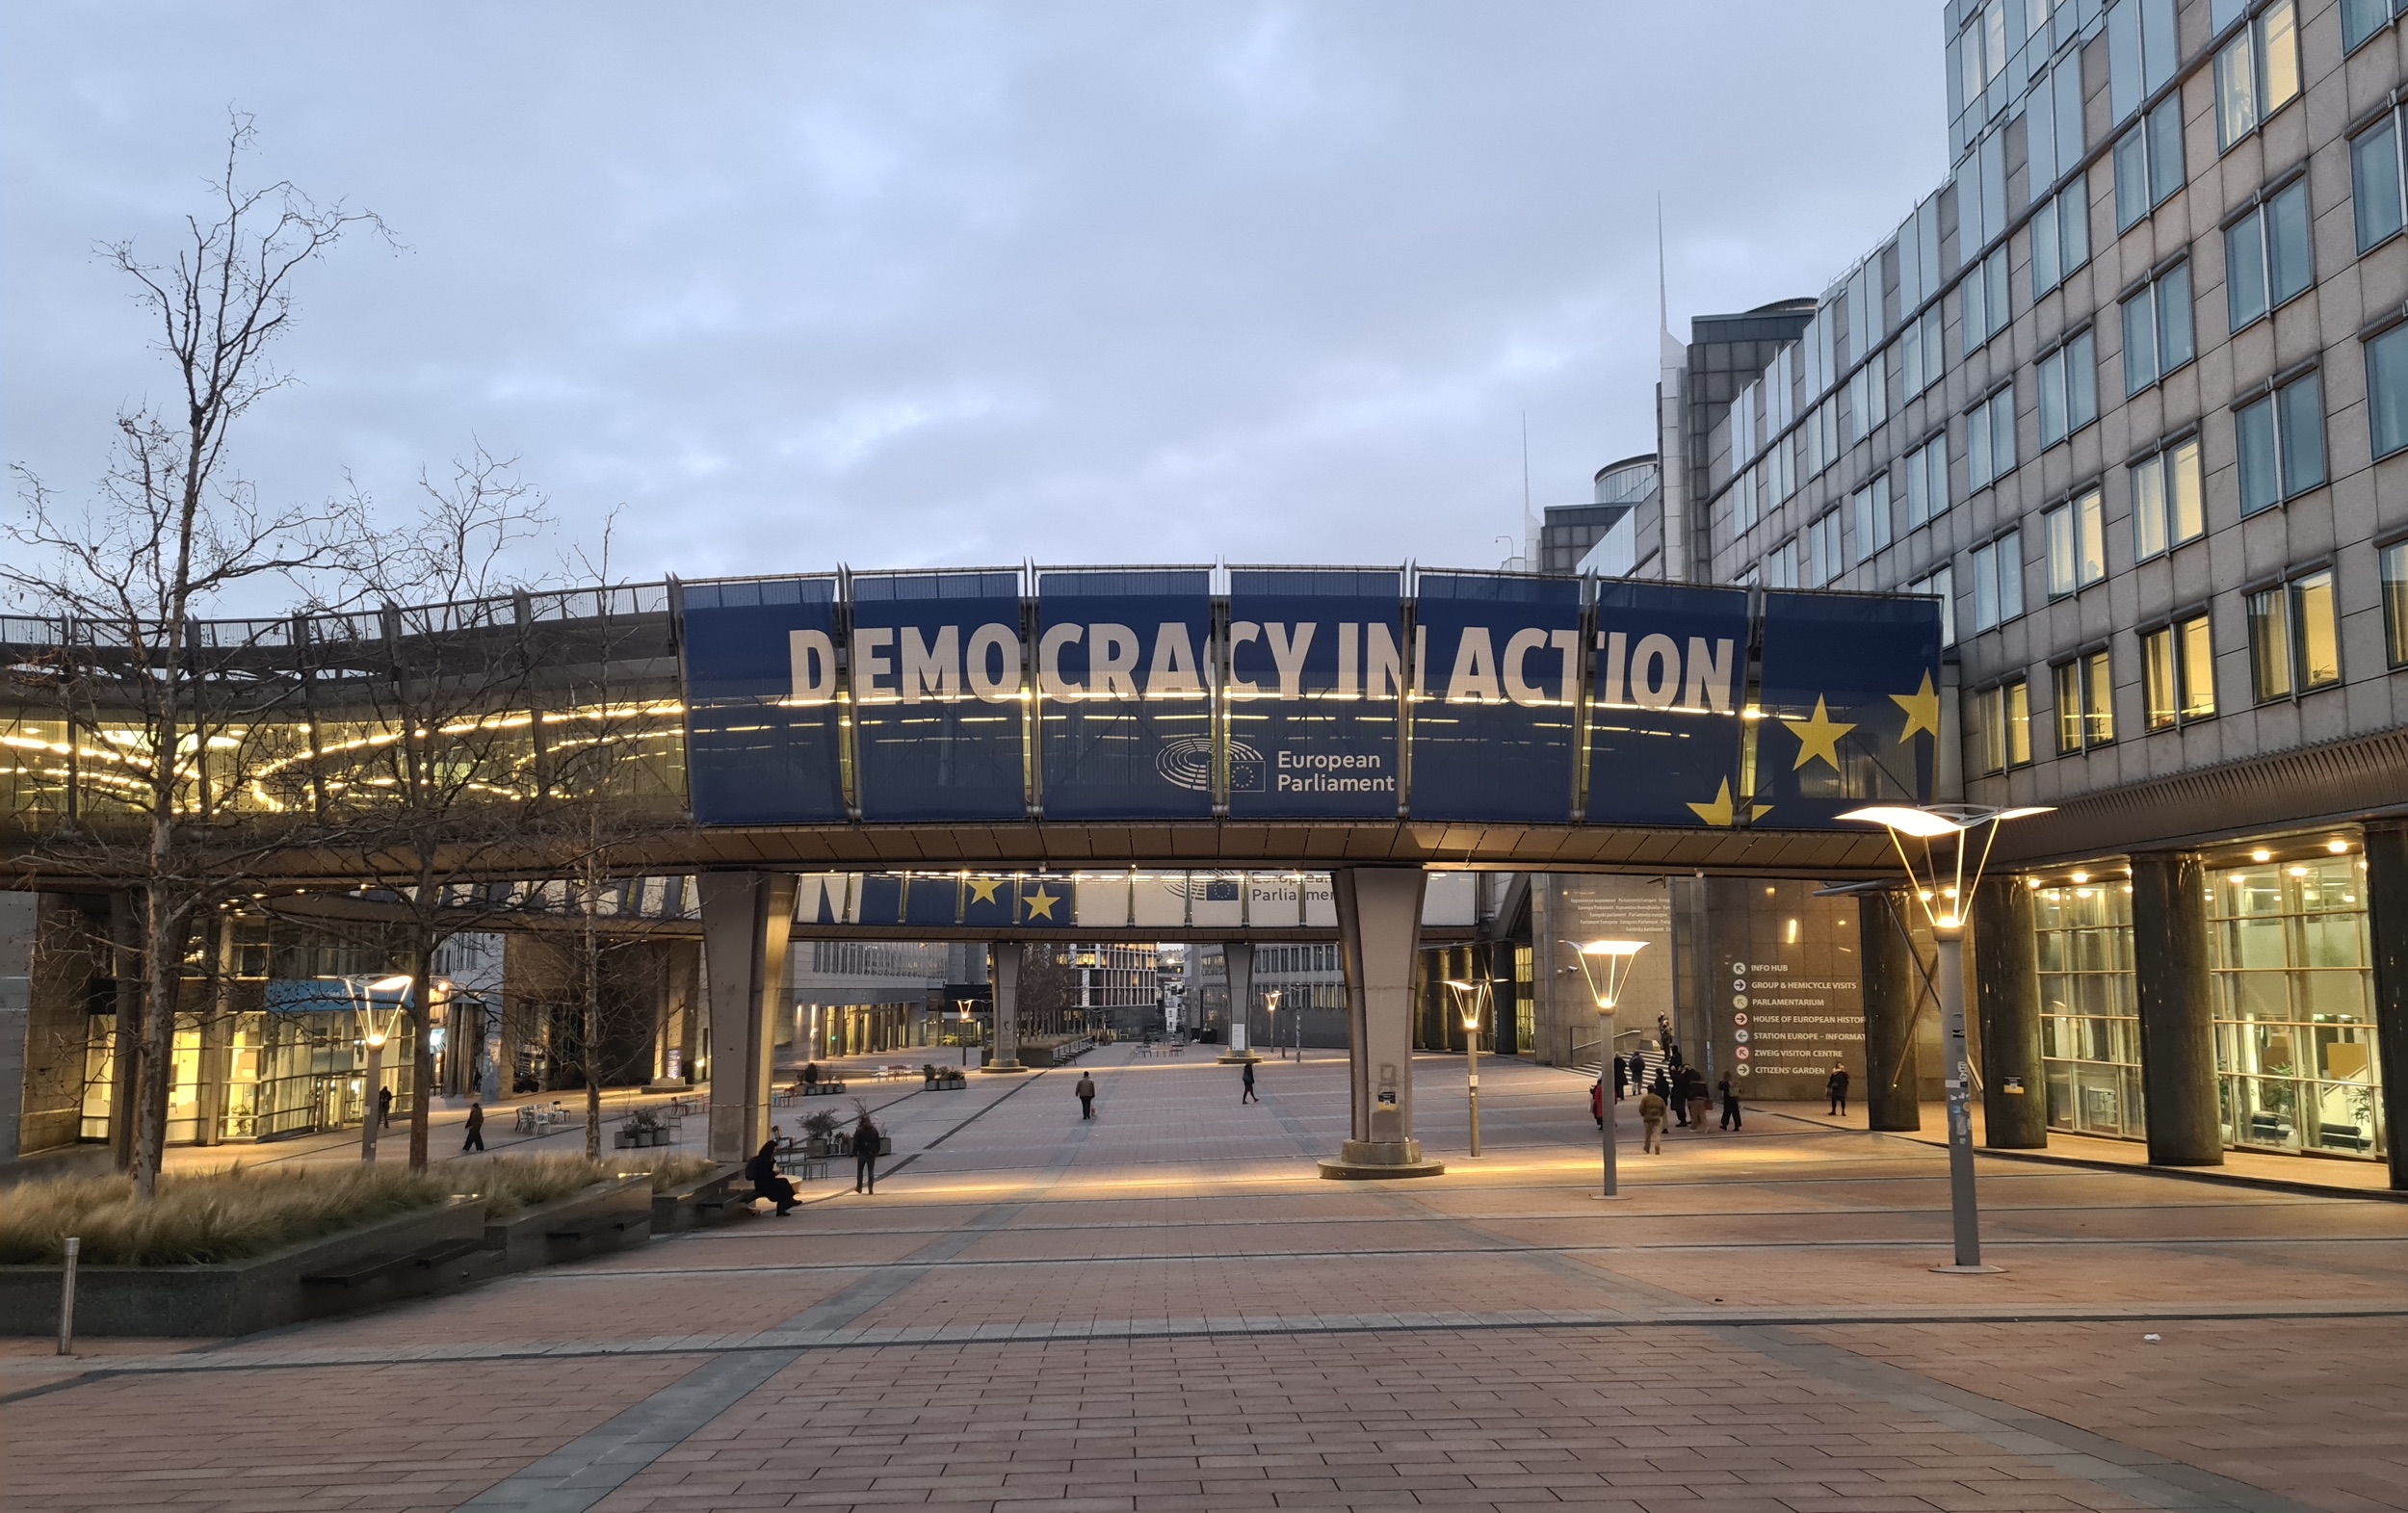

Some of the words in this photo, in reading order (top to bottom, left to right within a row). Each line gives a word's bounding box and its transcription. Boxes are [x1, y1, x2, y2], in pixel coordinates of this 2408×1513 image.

[789, 621, 1317, 707] DEMOCRACY
[1338, 622, 1426, 704] IN
[1446, 626, 1735, 715] ACTION
[1277, 750, 1380, 771] European
[1277, 772, 1395, 792] Parliament
[1252, 888, 1334, 901] Parliame
